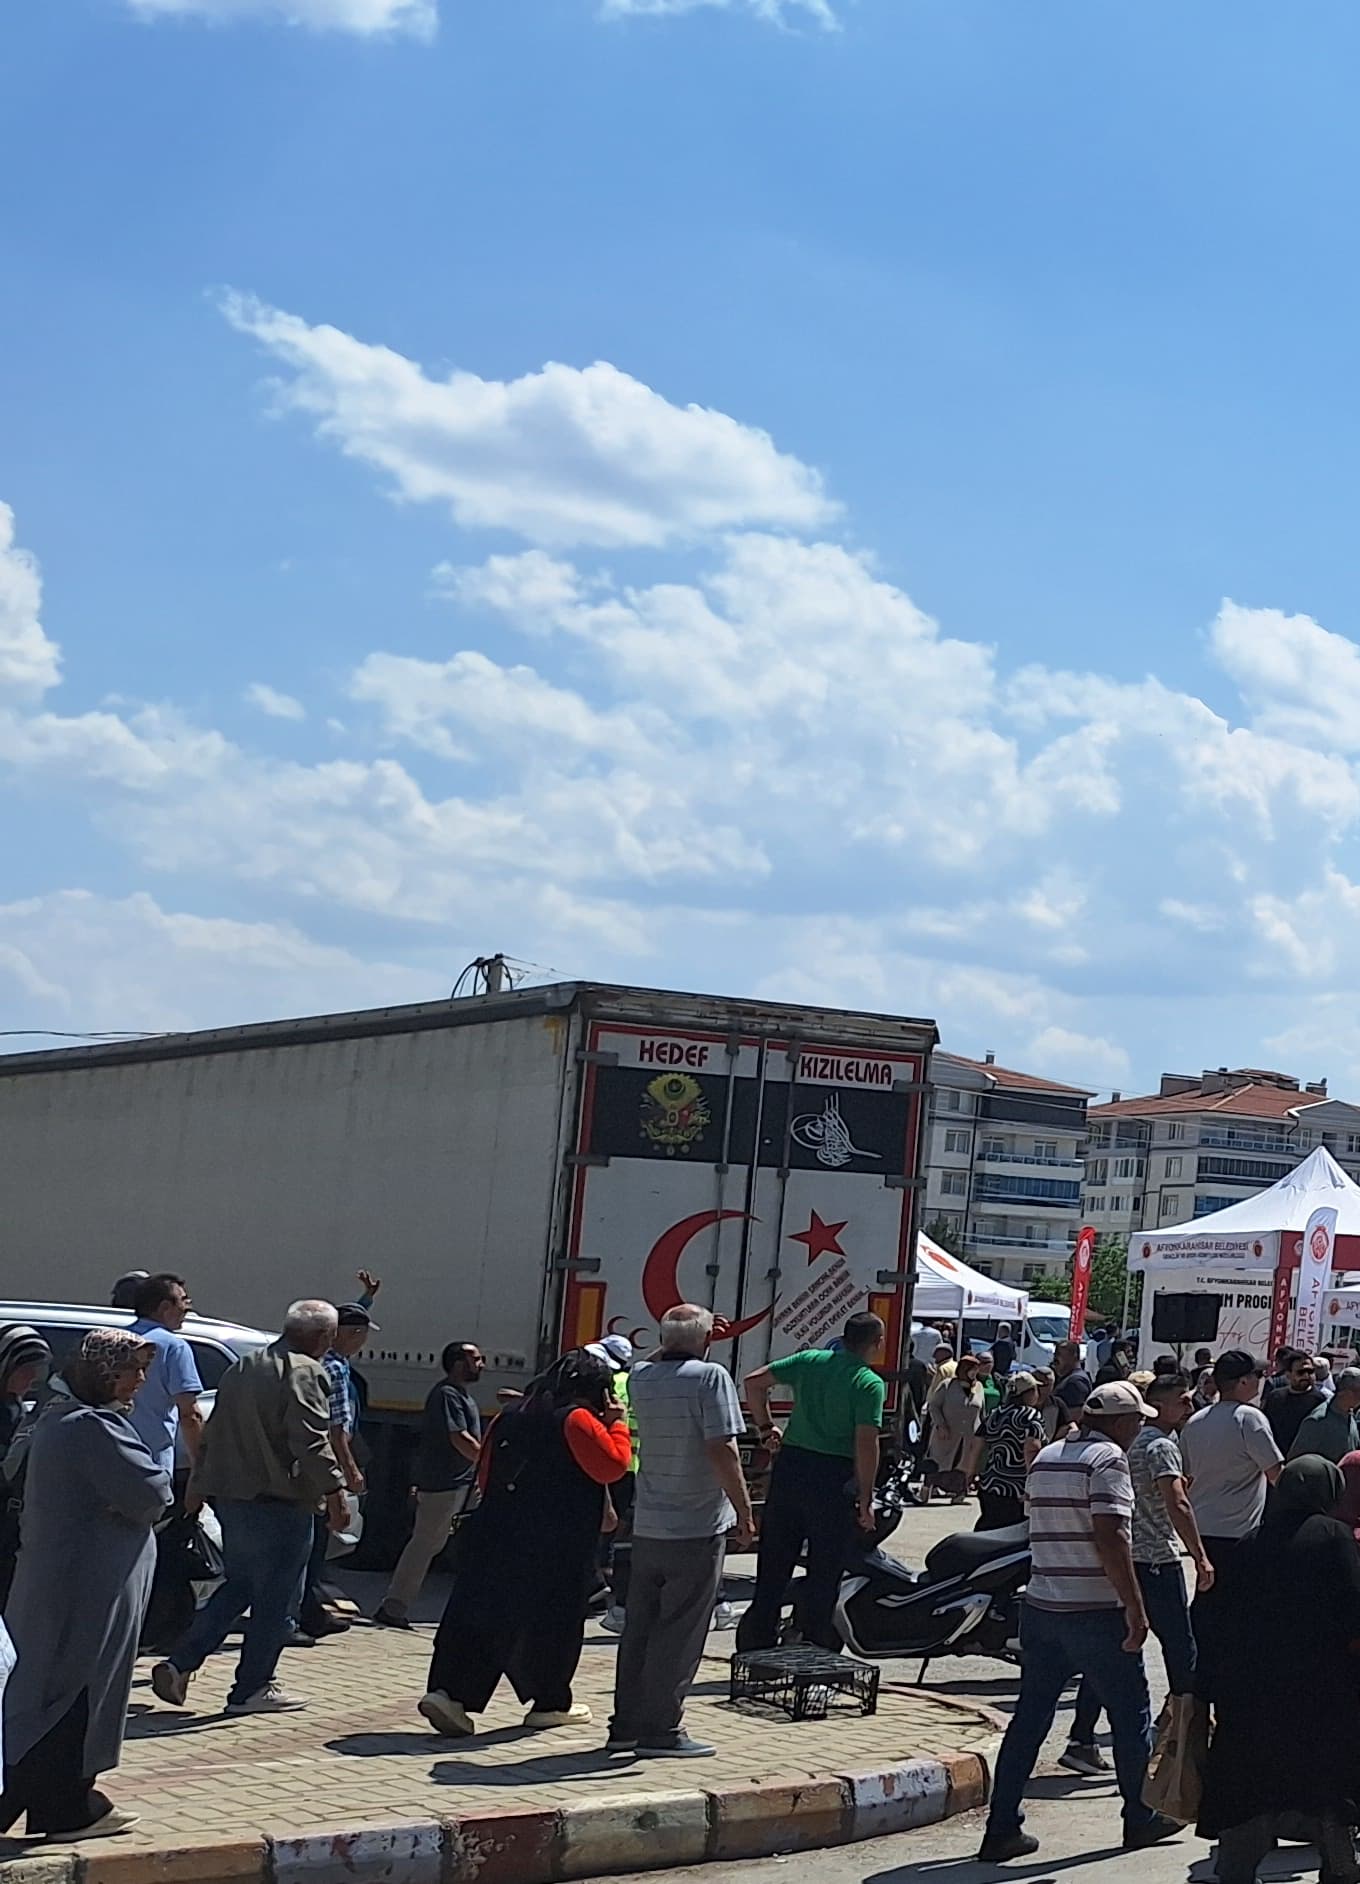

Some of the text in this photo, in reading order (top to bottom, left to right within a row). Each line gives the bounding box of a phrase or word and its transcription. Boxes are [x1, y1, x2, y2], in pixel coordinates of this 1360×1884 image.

[639, 1040, 708, 1067] HEDEF
[801, 1054, 892, 1085] KIZILELMA
[1296, 1306, 1308, 1349] BELE
